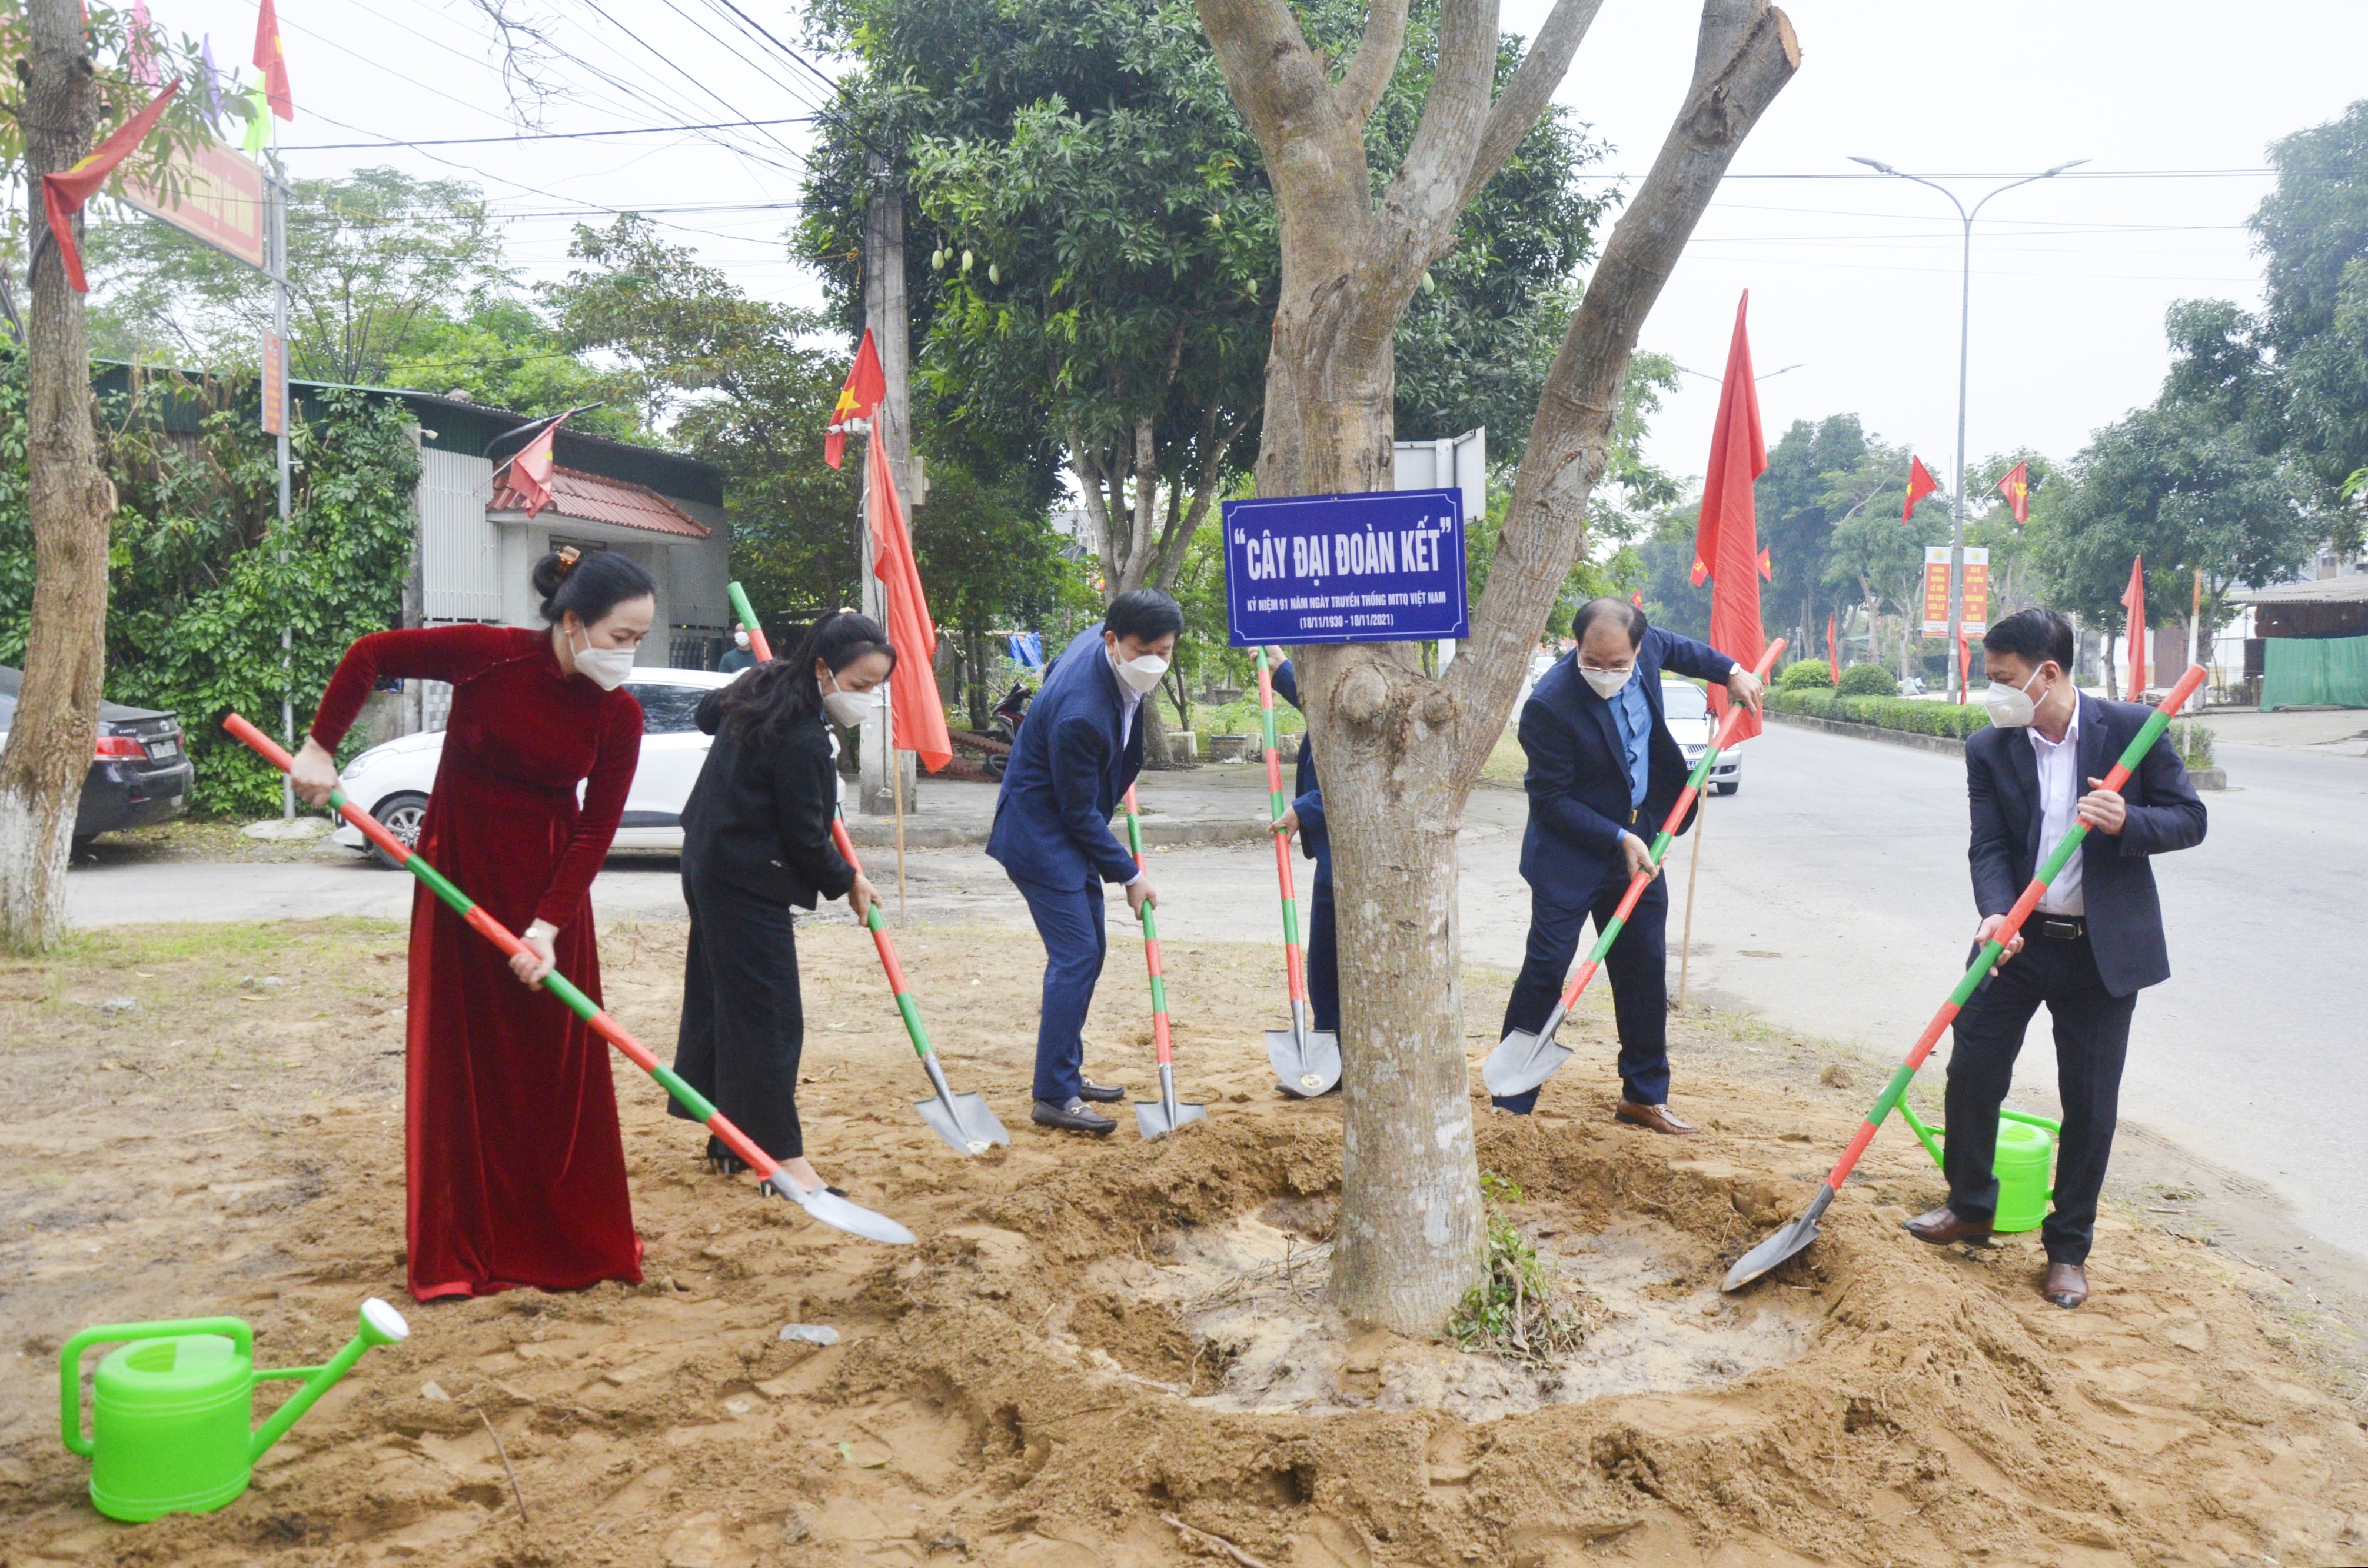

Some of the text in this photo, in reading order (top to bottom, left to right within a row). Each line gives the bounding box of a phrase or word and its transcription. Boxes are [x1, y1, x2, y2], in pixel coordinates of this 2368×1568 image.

[1234, 515, 1452, 587] “CÂY ĐẠI ĐOÀN KẾT”
[1258, 597, 1278, 613] NIỆM
[1279, 598, 1288, 610] 91
[1290, 595, 1308, 610] NĂM
[1309, 594, 1329, 609] NGÀY
[1361, 590, 1386, 607] THỐNG
[1388, 593, 1409, 607] MTTQ
[1409, 590, 1426, 607] VIỆT
[1428, 591, 1446, 604] NAM
[1299, 615, 1343, 630] (18/11/1930
[1349, 614, 1394, 627] 18/11/2021)
